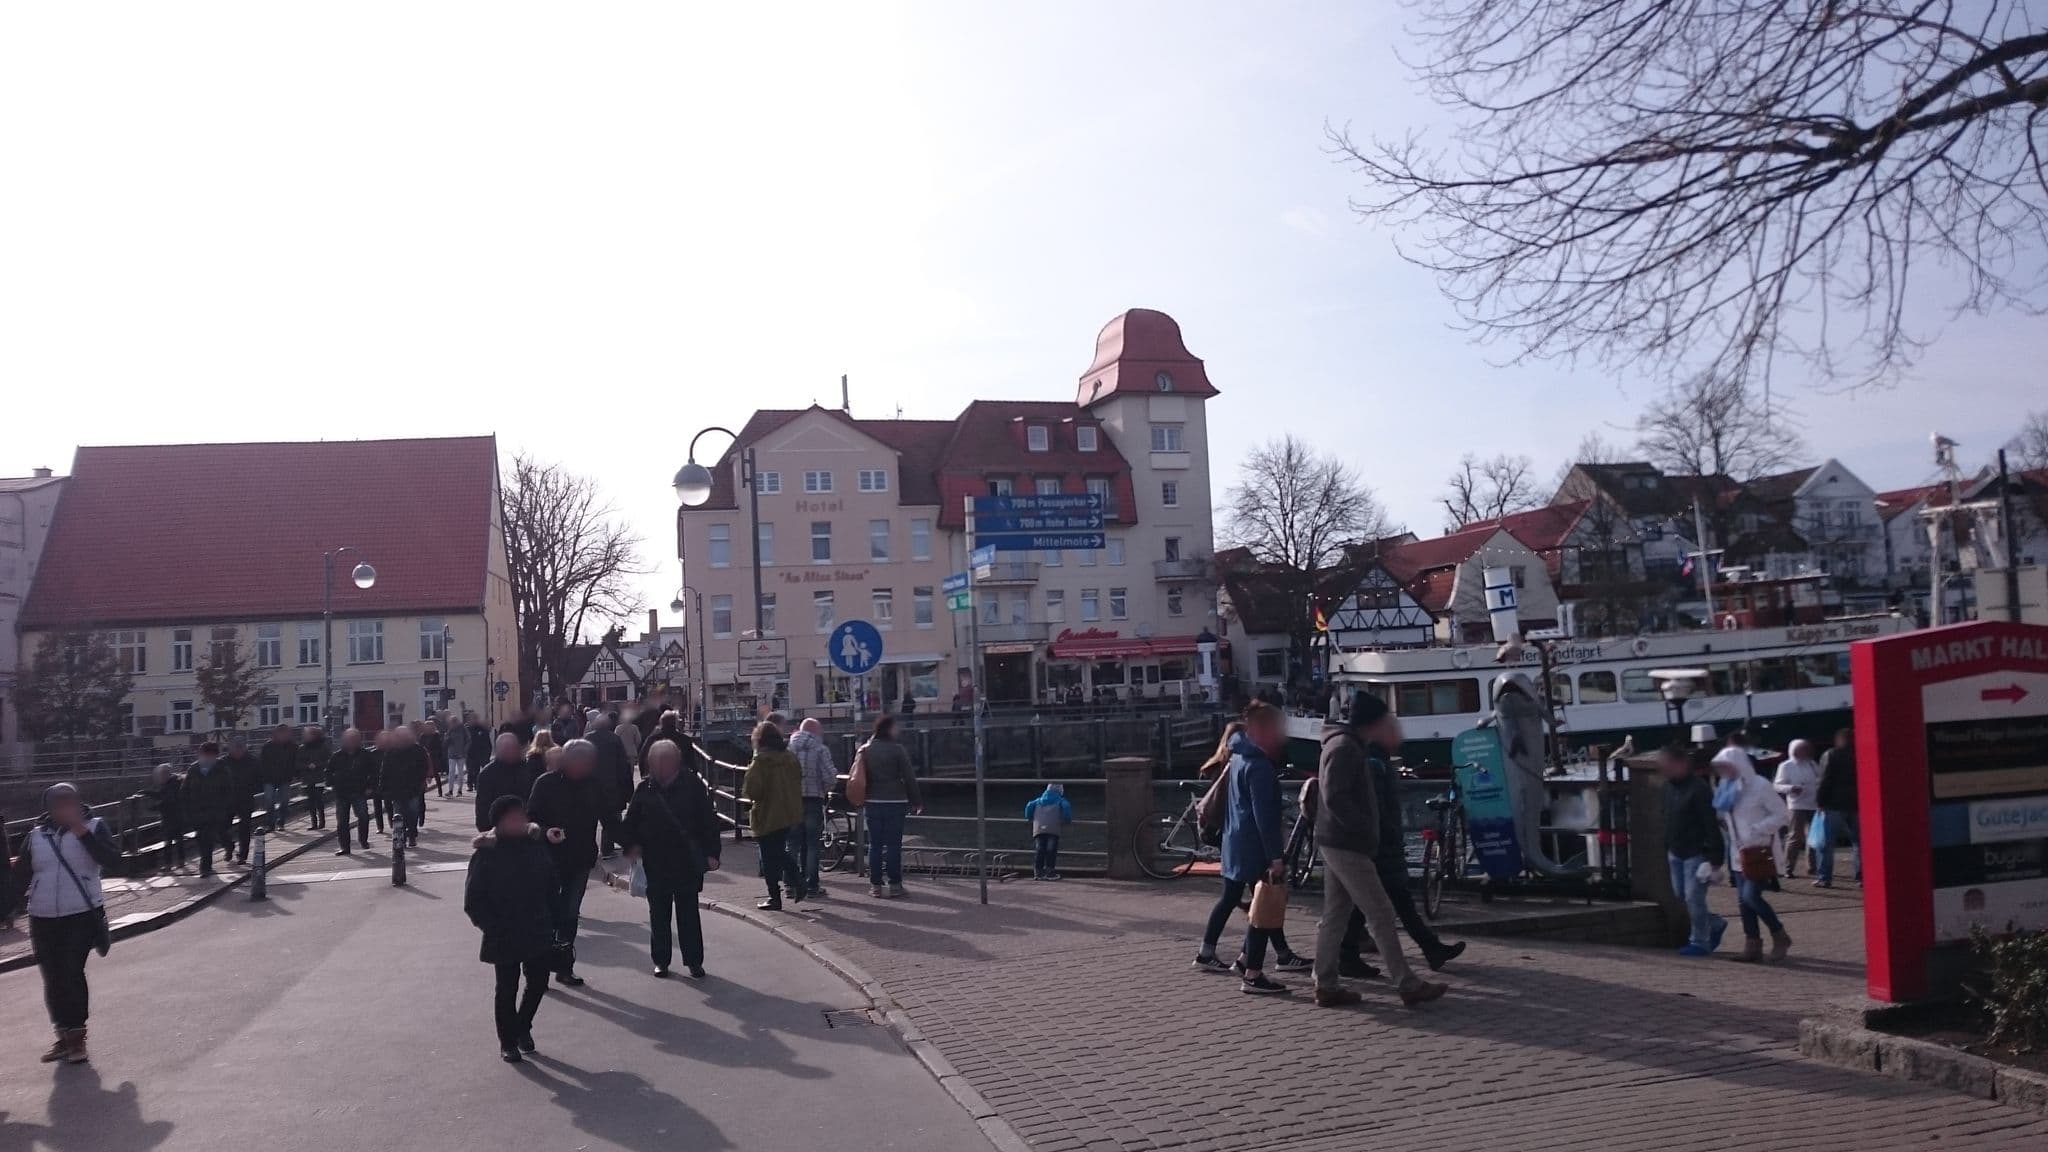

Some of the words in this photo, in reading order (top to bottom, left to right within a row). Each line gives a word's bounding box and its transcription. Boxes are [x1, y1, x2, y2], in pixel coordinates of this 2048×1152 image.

[796, 500, 843, 512] Hotel
[1033, 537, 1089, 547] Mittelmole
[1499, 589, 1515, 606] M
[1911, 636, 1995, 671] MARKT
